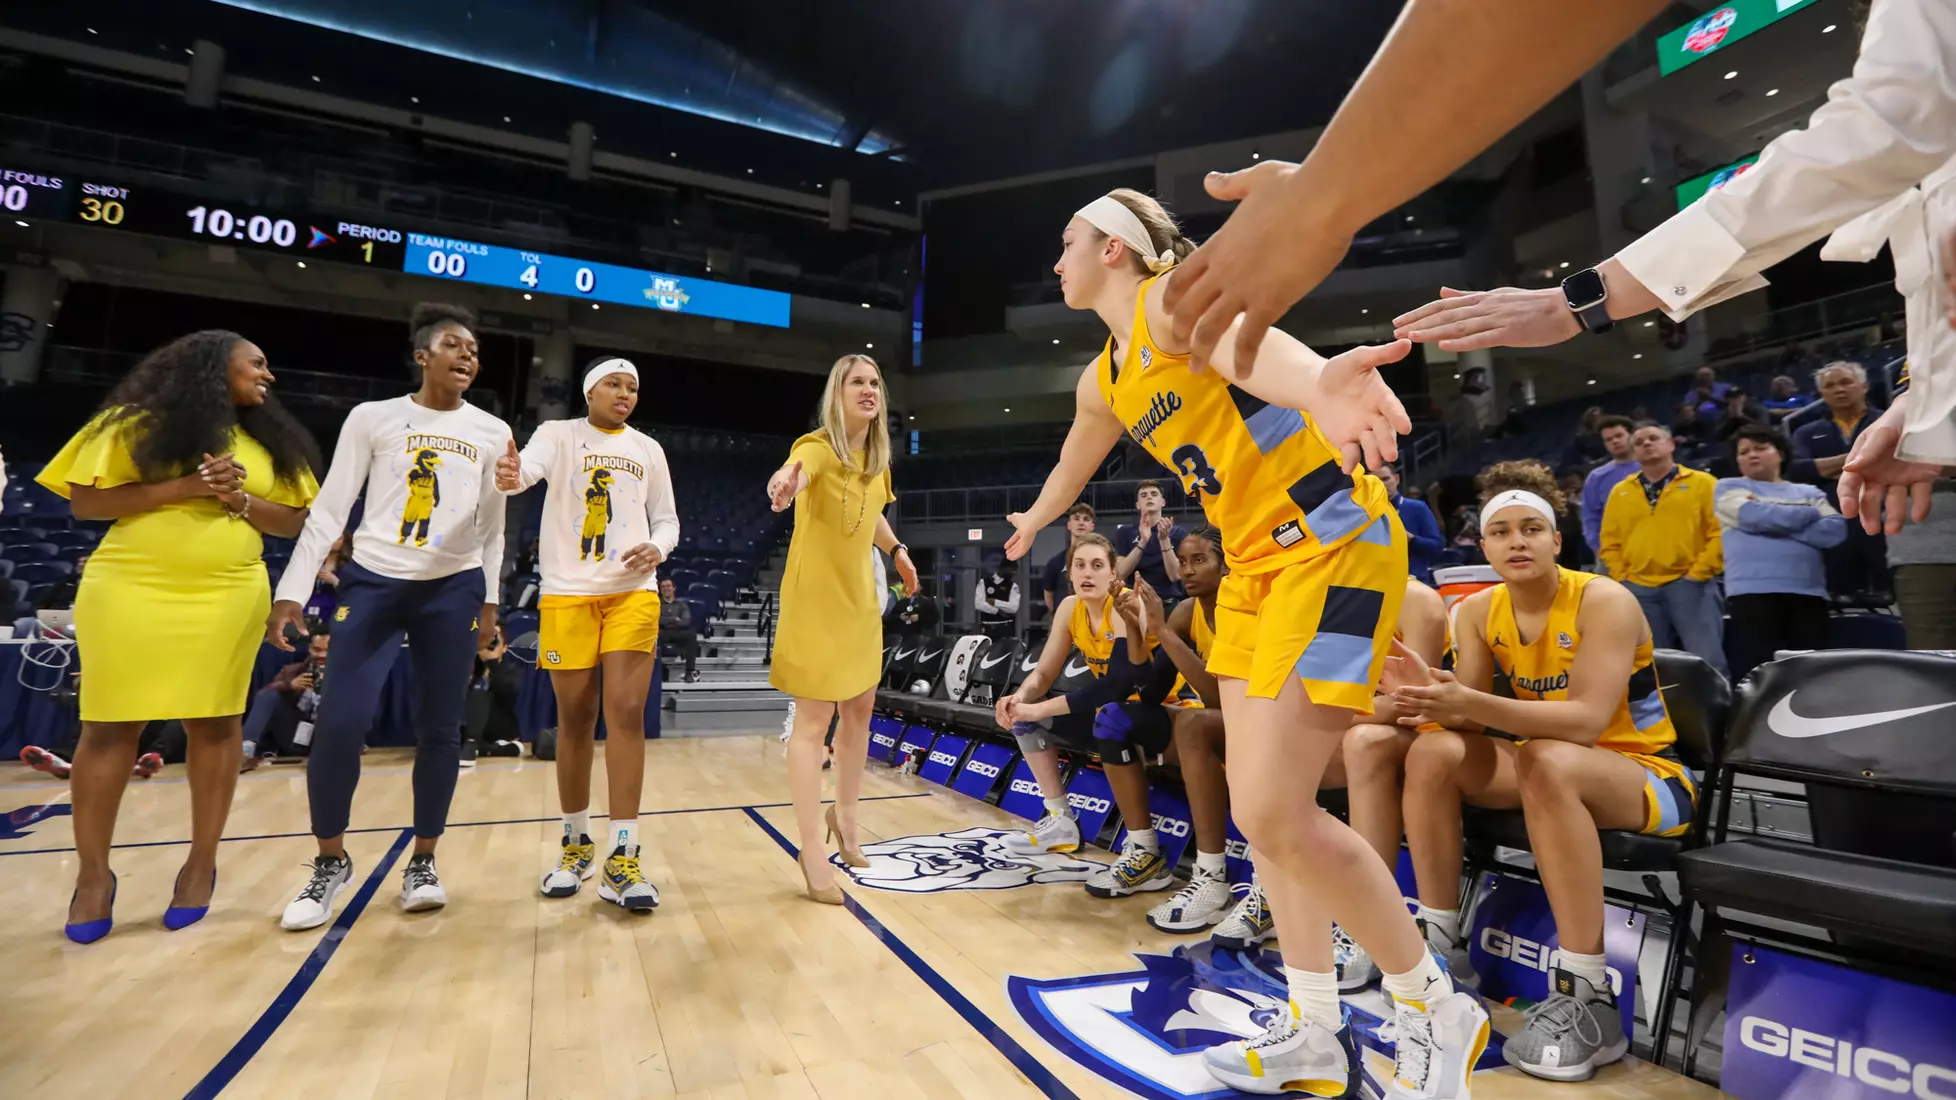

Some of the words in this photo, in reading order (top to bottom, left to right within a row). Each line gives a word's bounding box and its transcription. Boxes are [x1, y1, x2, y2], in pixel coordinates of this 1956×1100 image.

[4, 170, 63, 190] FOULS
[81, 182, 130, 200] SHOT
[0, 184, 28, 211] 0
[79, 197, 125, 224] 30
[186, 206, 297, 247] 10:00
[337, 222, 402, 243] PERIOD
[360, 241, 374, 263] 1
[408, 233, 445, 250] TEAM
[446, 239, 489, 256] FOULS
[427, 250, 467, 278] 00
[520, 252, 542, 265] TOL
[519, 265, 539, 288] 4
[575, 267, 595, 293] 0
[406, 434, 478, 463] MARQUETTE
[583, 455, 644, 480] MARQUETTE
[872, 733, 896, 748] GEICO
[929, 750, 957, 767] GEICO
[966, 759, 1000, 778] GEICO
[1066, 792, 1111, 814] GEICO
[1149, 812, 1190, 838] EICO
